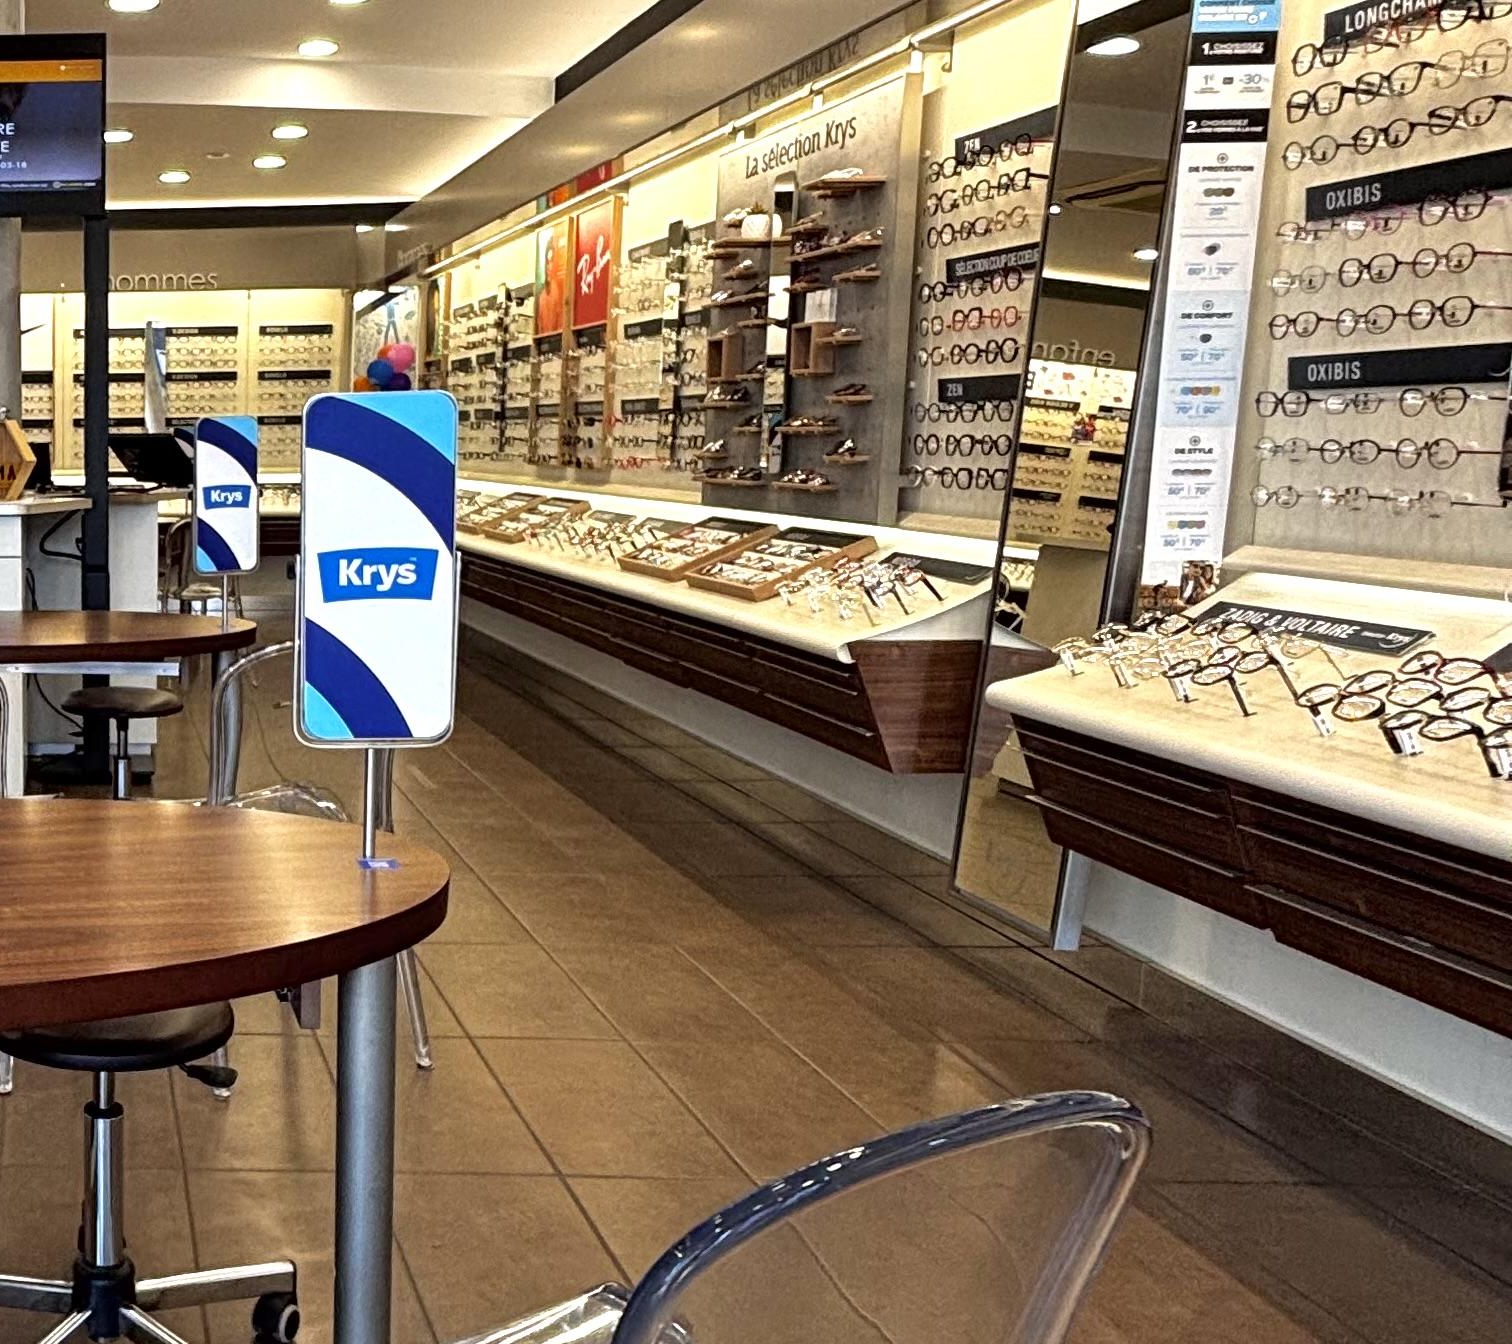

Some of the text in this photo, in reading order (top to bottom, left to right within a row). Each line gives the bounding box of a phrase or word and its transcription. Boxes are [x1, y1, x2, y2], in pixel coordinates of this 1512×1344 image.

[745, 116, 857, 179] La sélection Krys
[963, 137, 981, 155] ZEN
[1326, 183, 1382, 210] OXIBIS
[1307, 361, 1361, 382] OXIBIS
[947, 383, 963, 397] ZEN
[211, 489, 243, 504] Krys
[339, 557, 417, 592] Krys
[1219, 608, 1263, 625] ZADIG
[1263, 614, 1281, 627] &
[1283, 616, 1361, 639] VOLTAIRE
